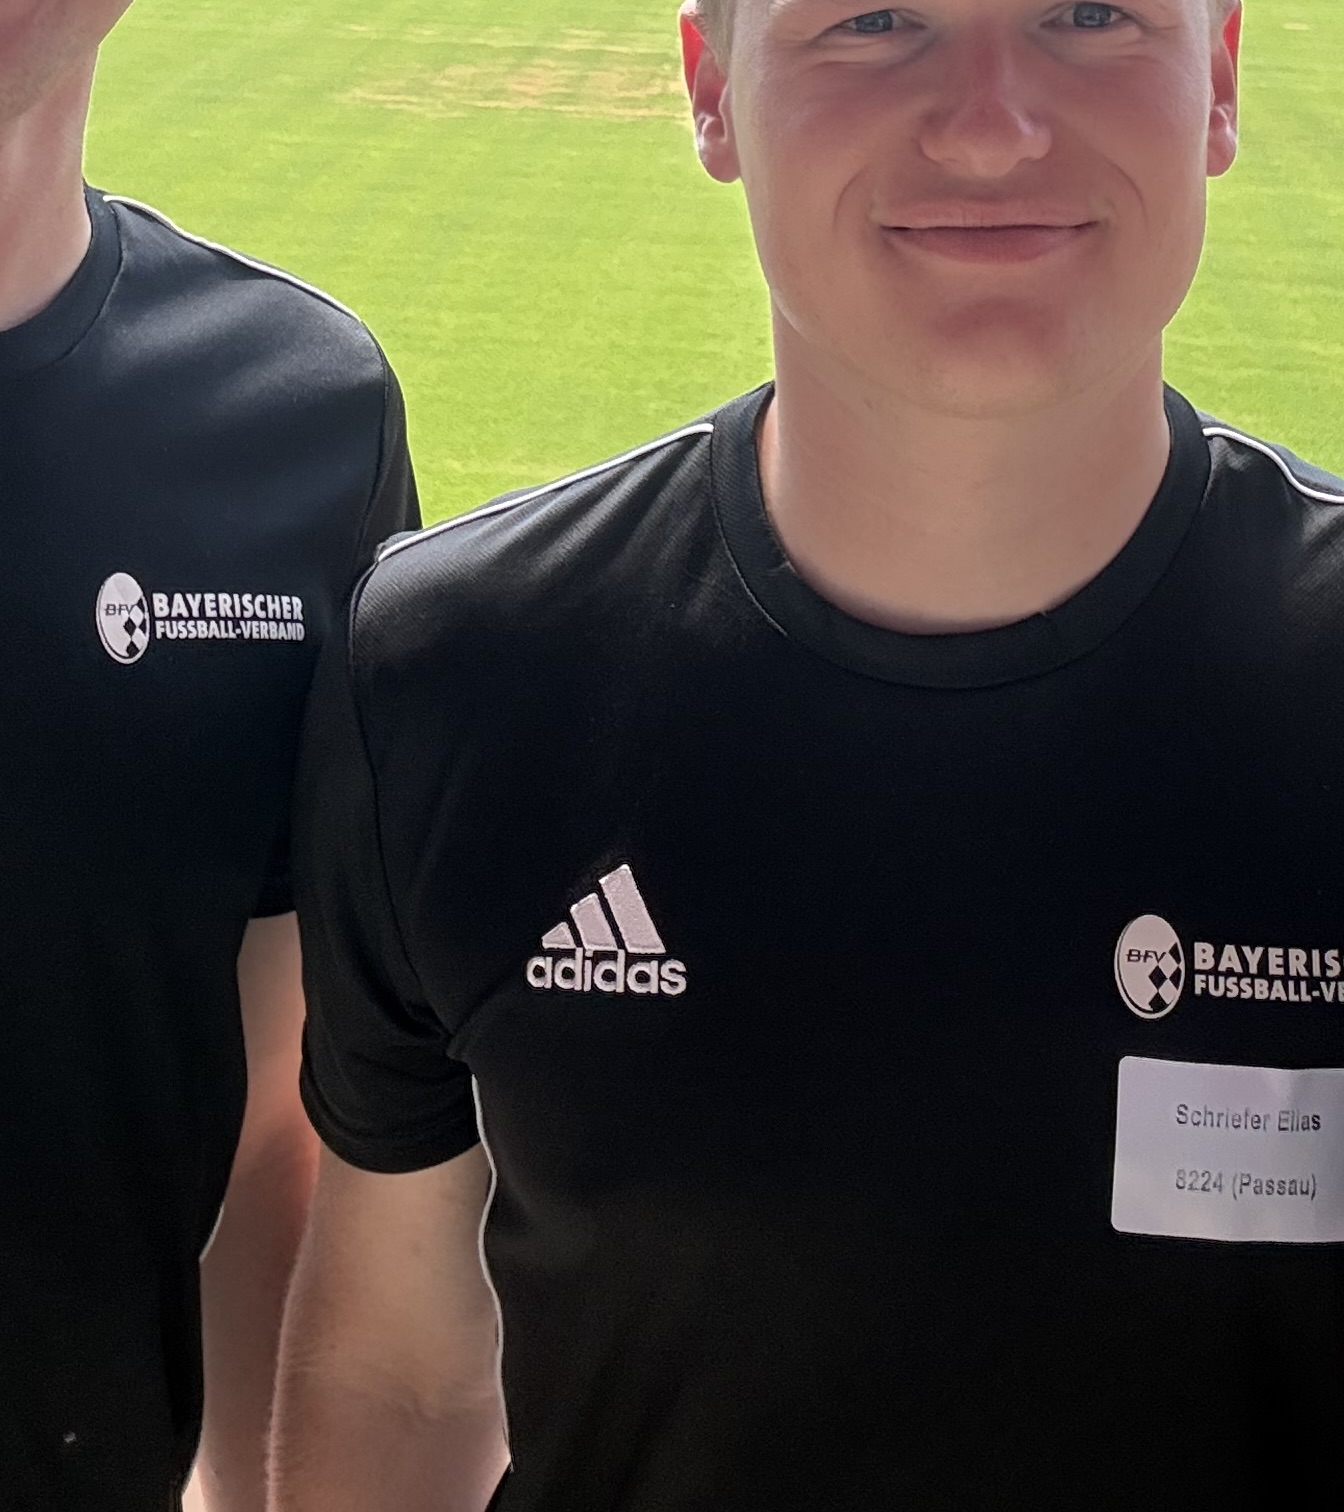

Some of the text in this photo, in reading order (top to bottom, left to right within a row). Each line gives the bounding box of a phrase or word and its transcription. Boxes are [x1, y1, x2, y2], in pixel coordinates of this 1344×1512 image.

[153, 593, 304, 620] BAYERISCHER
[156, 620, 305, 641] FUSSBALL-VERBAND
[1126, 949, 1166, 963] BFV
[526, 947, 687, 995] adidas
[1176, 1104, 1321, 1132] Schriefer Elias
[1175, 1168, 1317, 1200] 8224 (Passau)
